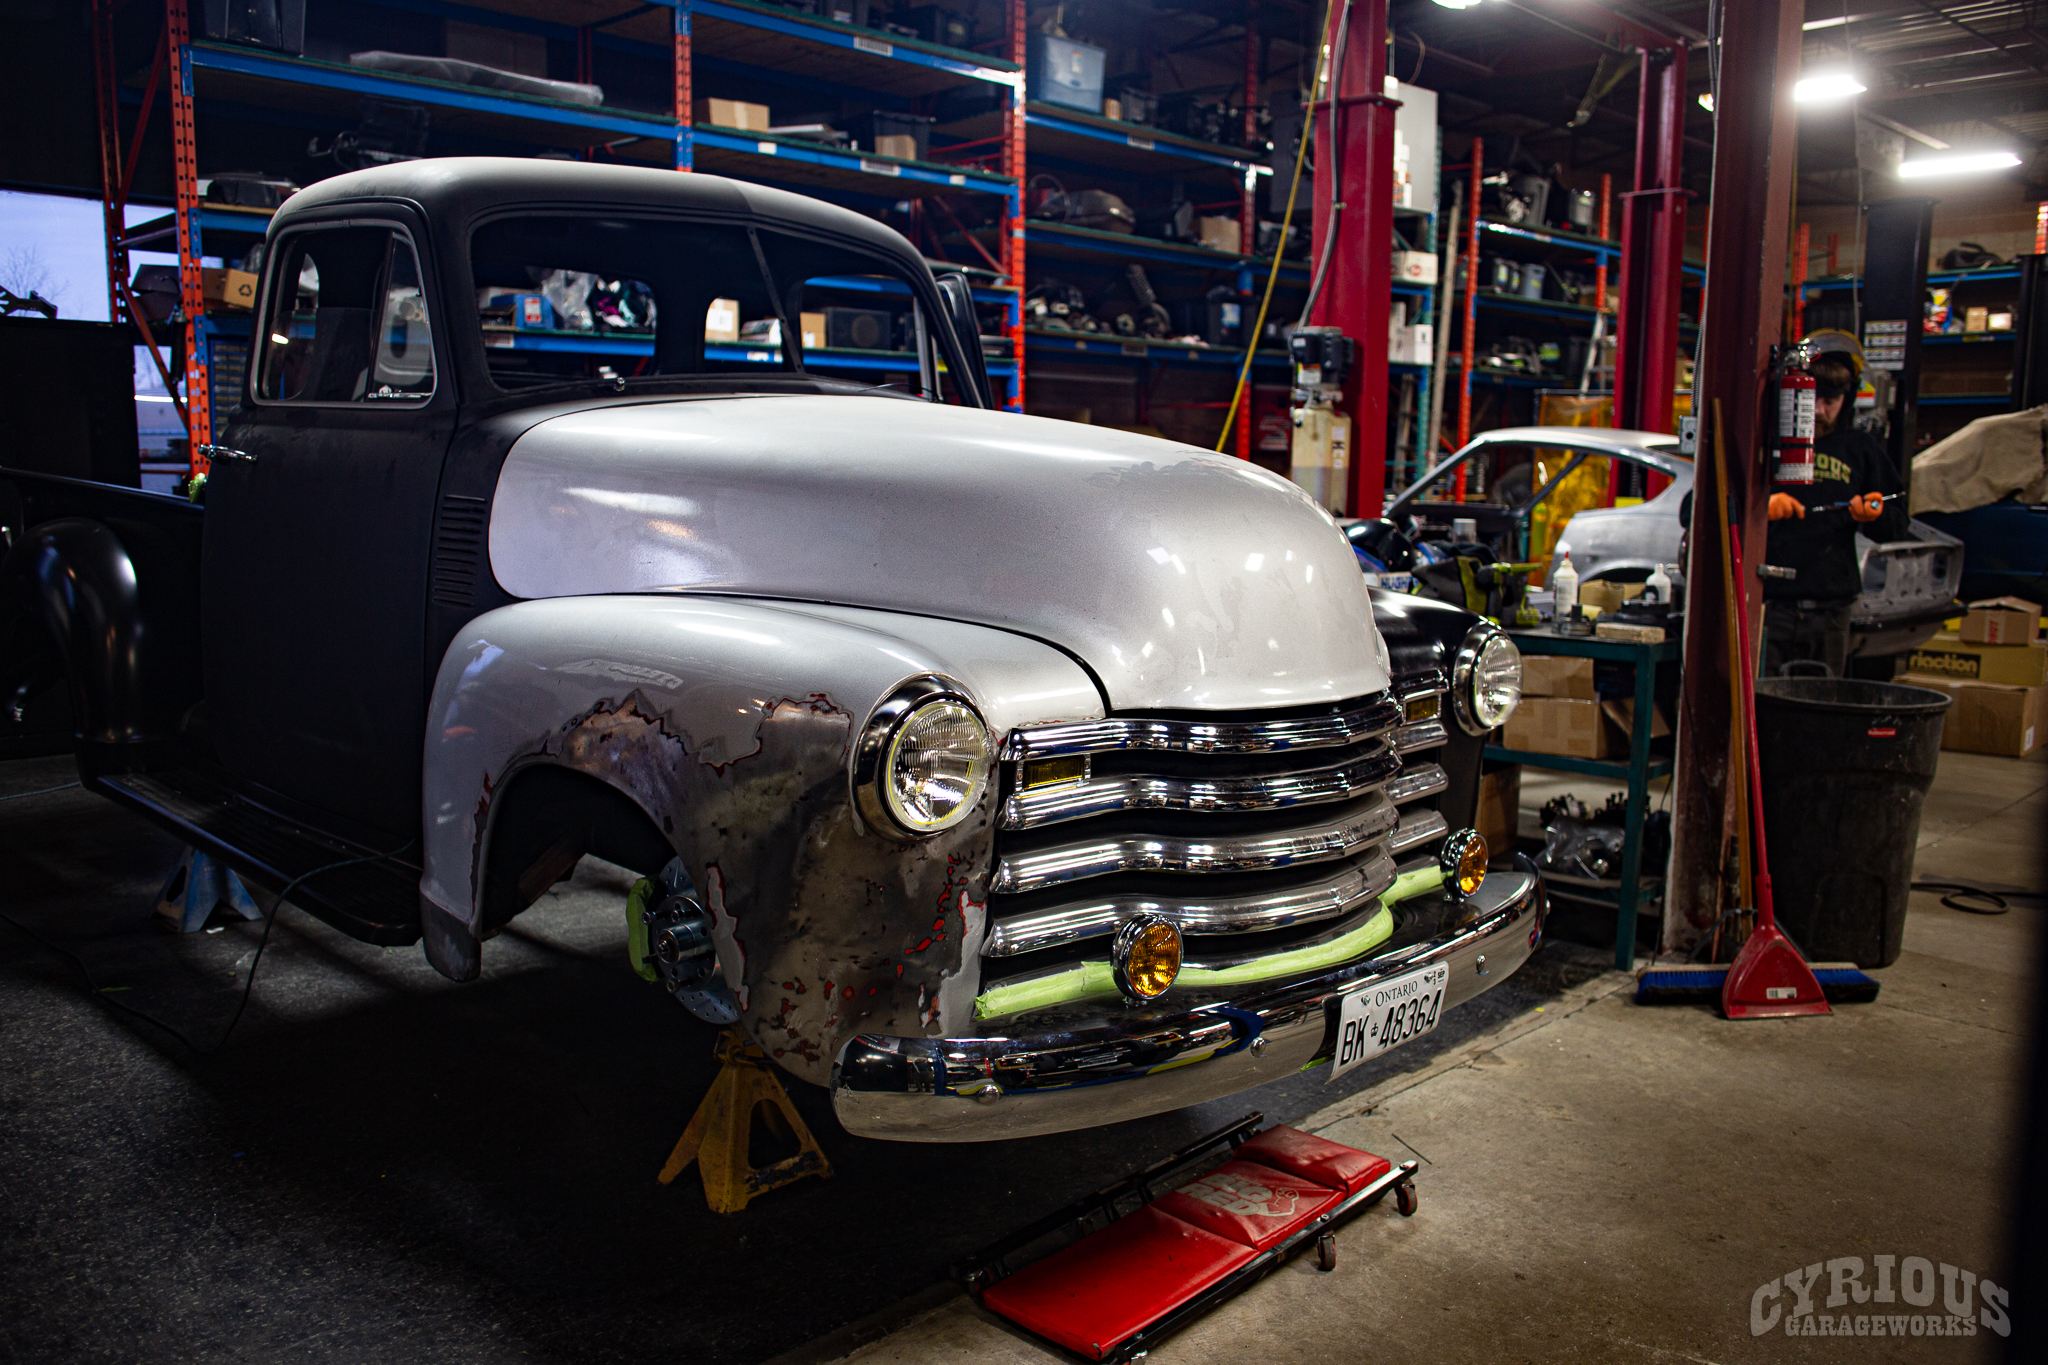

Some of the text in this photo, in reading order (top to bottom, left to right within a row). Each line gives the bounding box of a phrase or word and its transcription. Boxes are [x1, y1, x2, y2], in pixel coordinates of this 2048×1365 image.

[1375, 980, 1418, 1007] ONTARIO
[1340, 988, 1442, 1066] BK 48364
[1175, 1182, 1260, 1215] RED
[1198, 1173, 1273, 1203] BIG
